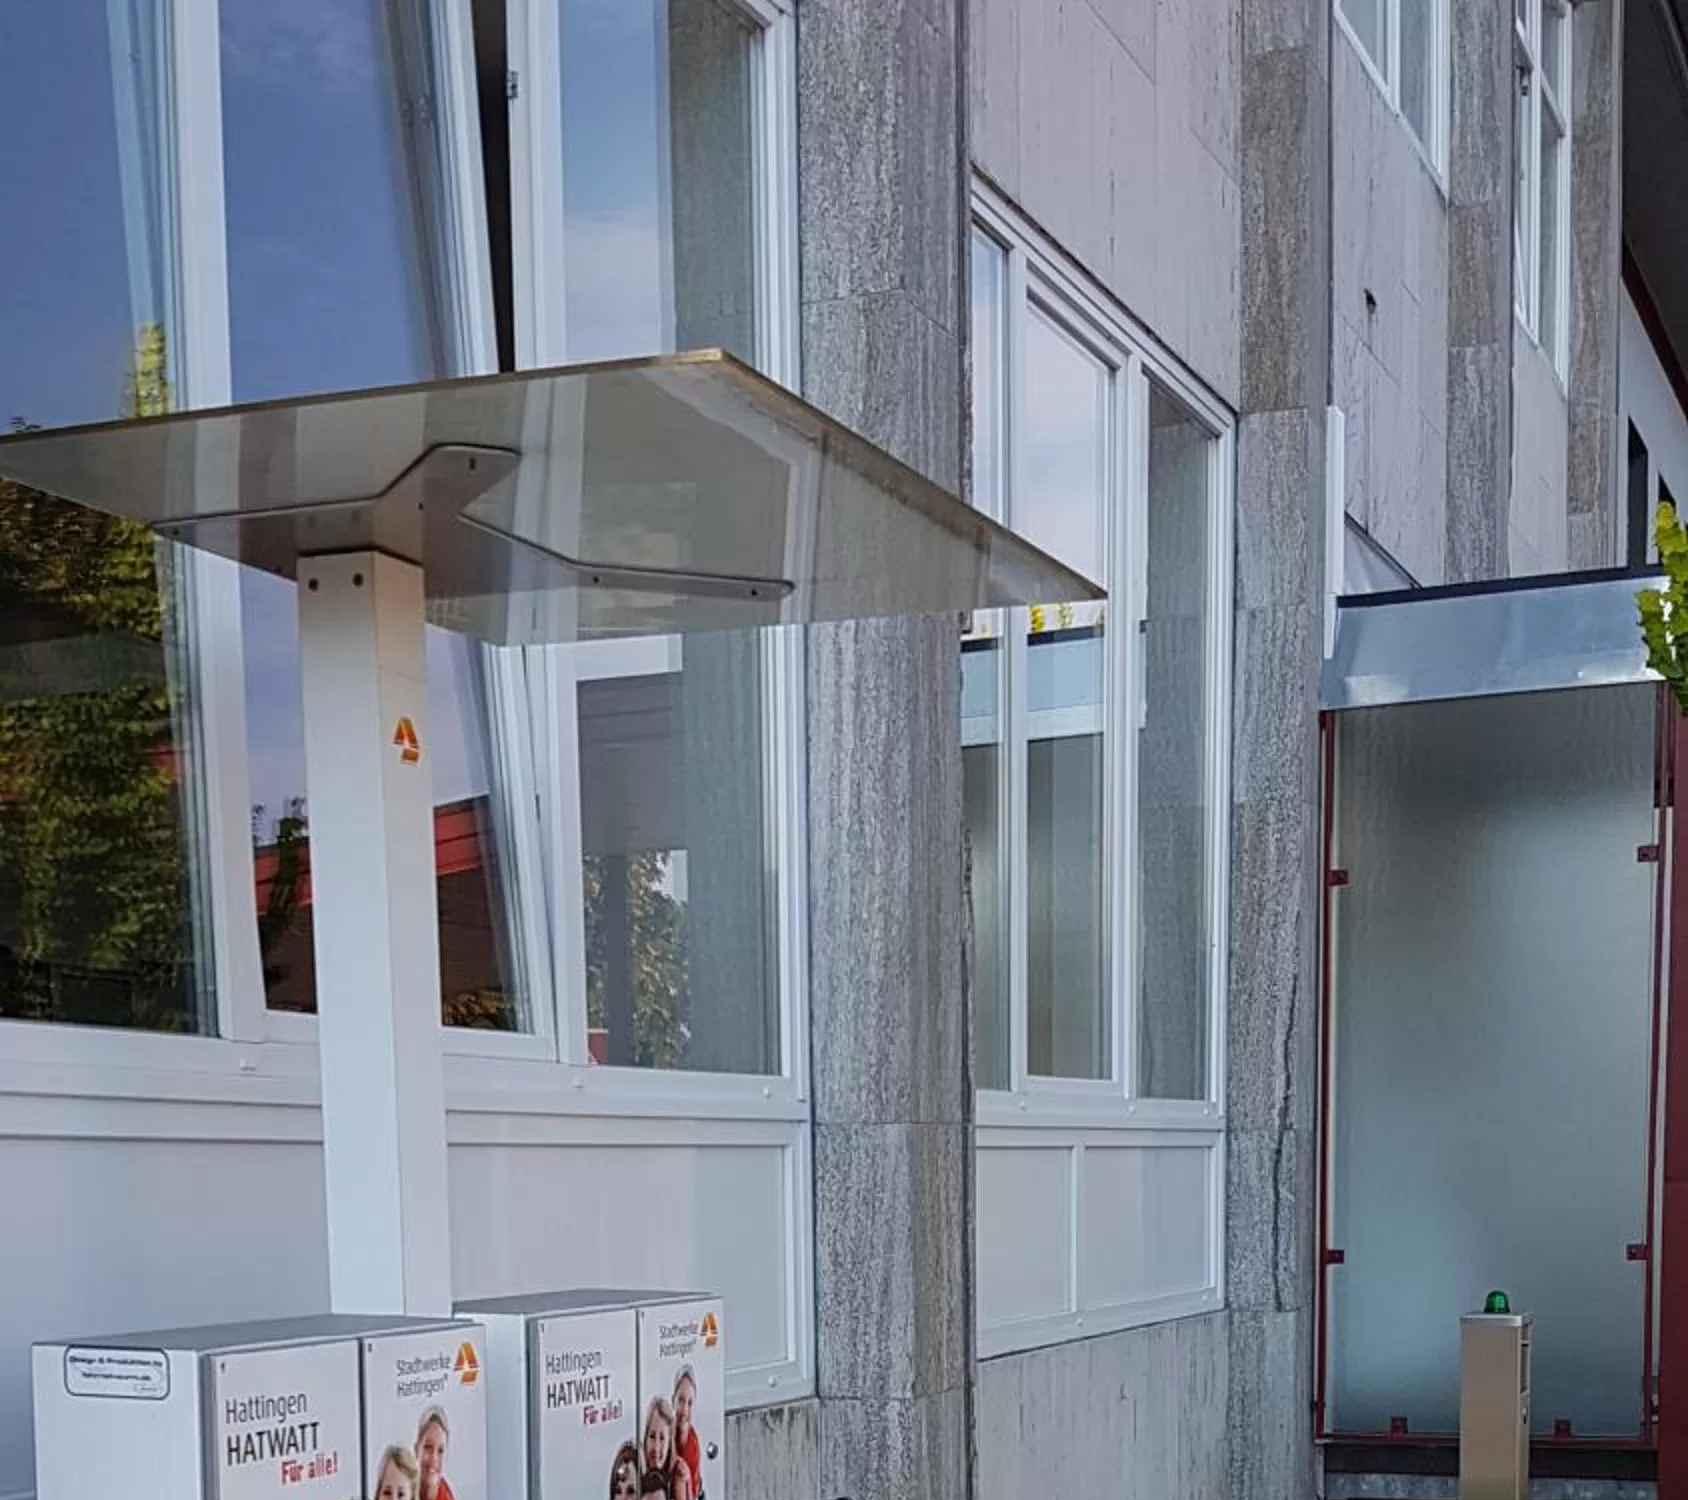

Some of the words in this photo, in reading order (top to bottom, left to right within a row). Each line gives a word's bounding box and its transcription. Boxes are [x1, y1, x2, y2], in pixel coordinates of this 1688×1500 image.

[396, 1352, 451, 1376] Stadtwerke
[545, 1351, 602, 1375] Hattingen
[547, 1375, 609, 1408] HATWATT
[225, 1393, 307, 1424] Hattingen
[227, 1422, 320, 1466] HATWATT
[281, 1459, 304, 1484] Für
[308, 1451, 338, 1480] alle!
